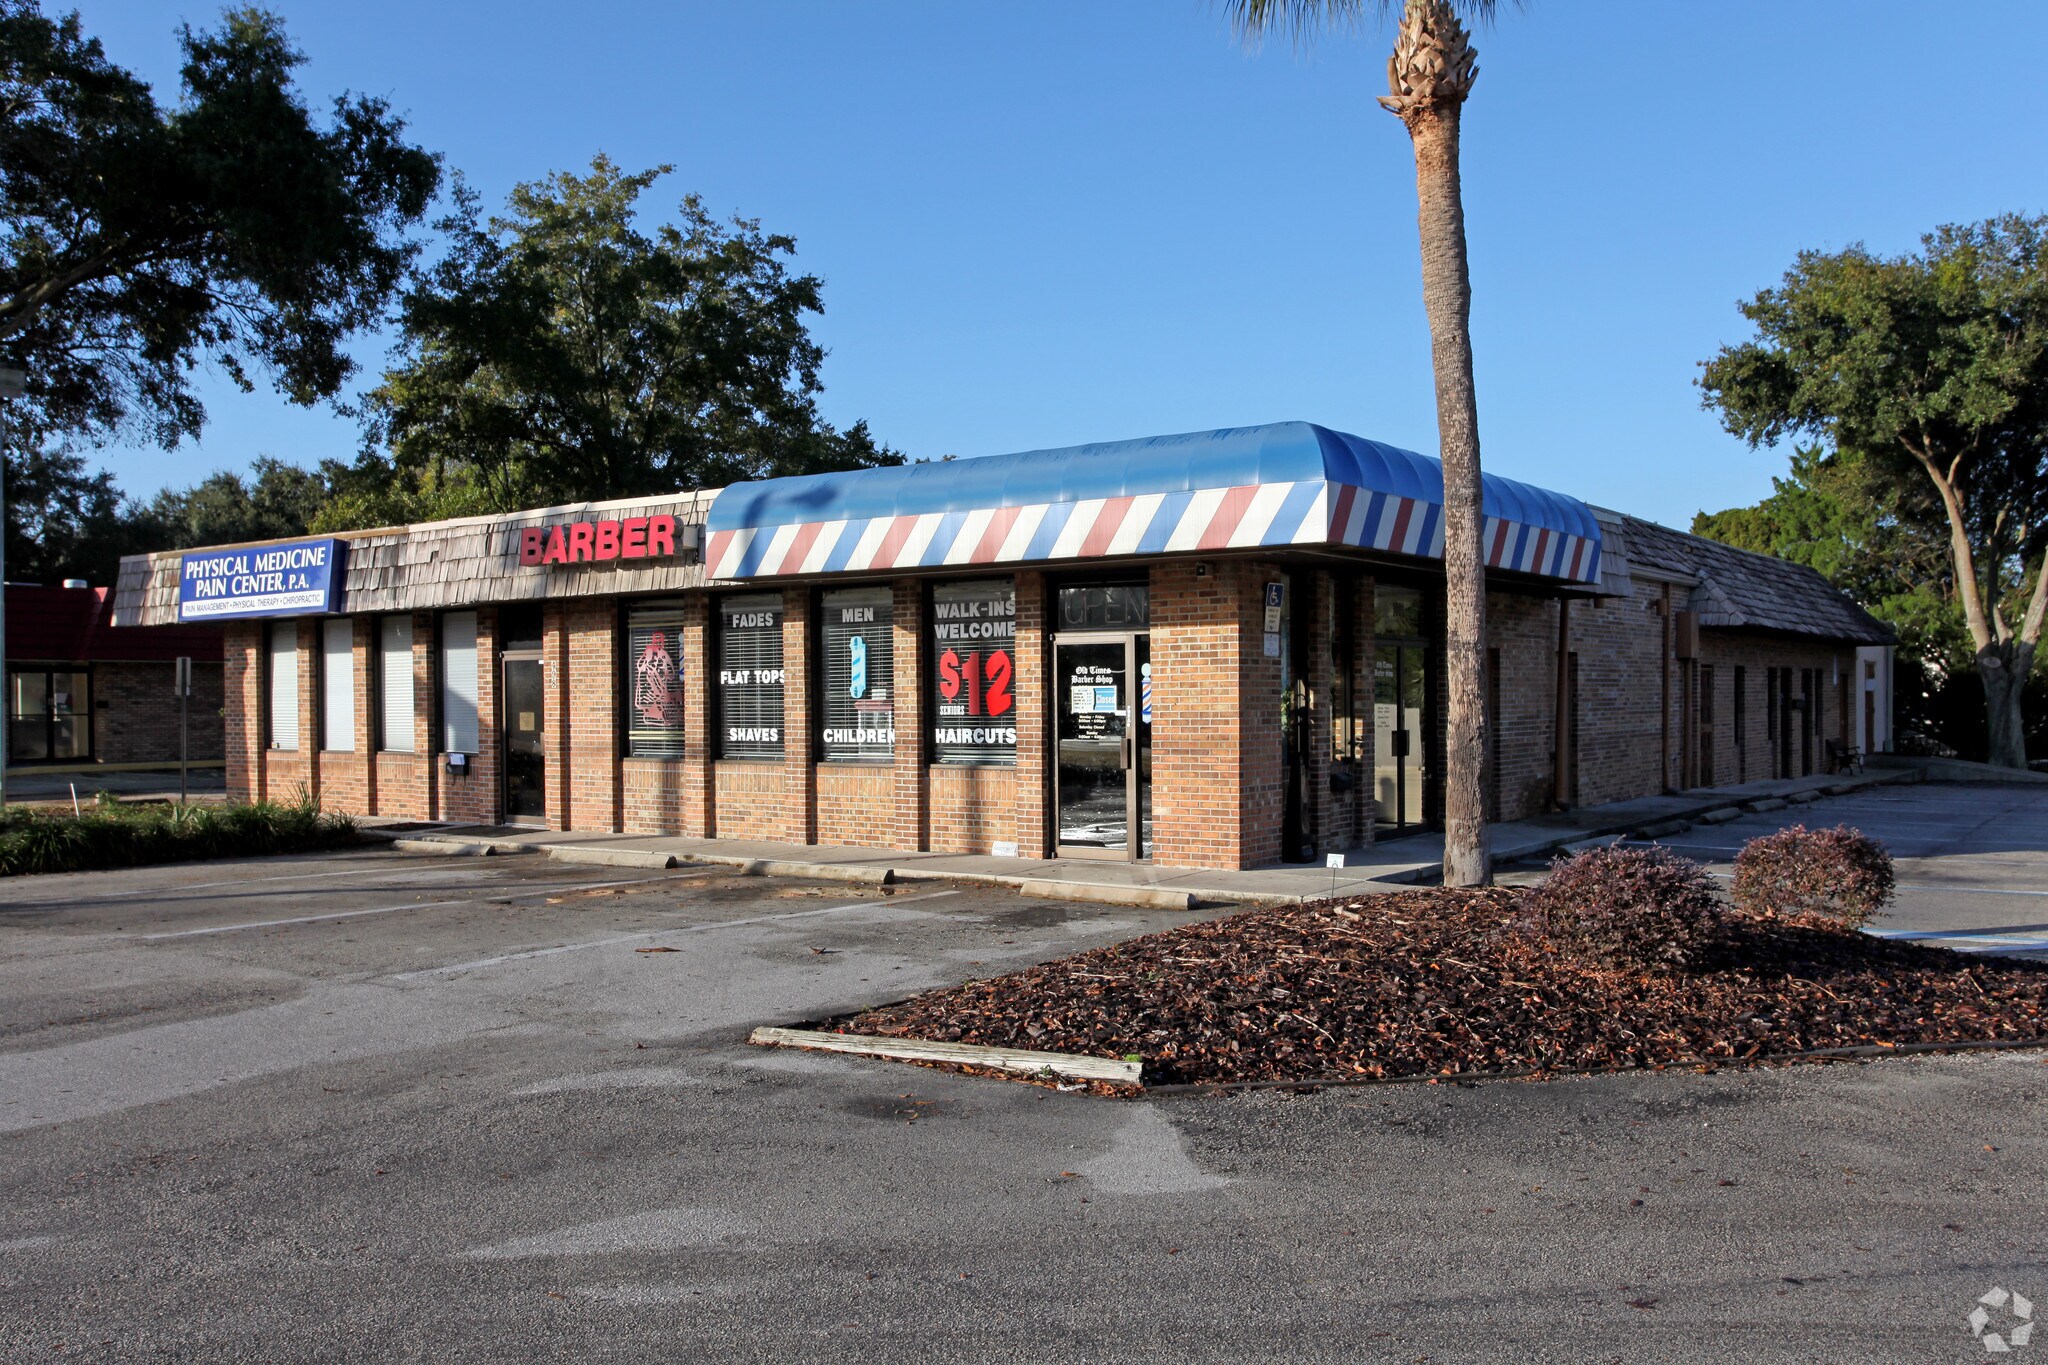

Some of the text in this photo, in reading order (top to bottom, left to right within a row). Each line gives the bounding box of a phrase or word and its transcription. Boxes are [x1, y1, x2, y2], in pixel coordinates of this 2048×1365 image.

[520, 514, 676, 566] BARBER
[186, 547, 326, 579] PHYSICAL MEDICINE
[196, 572, 310, 598] PAIN CENTER, P.A.
[185, 594, 320, 613] PAIN MANAGEMENT PHYSICAL THERAPY CHIROPRACTIC
[935, 600, 1016, 618] WALK-INS
[732, 612, 774, 628] FADES
[842, 608, 874, 622] MEN
[934, 621, 1016, 638] WELCOME
[720, 670, 750, 684] FLAT
[940, 648, 1012, 716] $12
[1071, 675, 1114, 684] Barber Shop
[940, 706, 964, 716] SENIORS
[730, 728, 778, 742] SHAVES
[823, 728, 896, 743] CHILDREN
[935, 728, 1016, 744] HAIRCUTS
